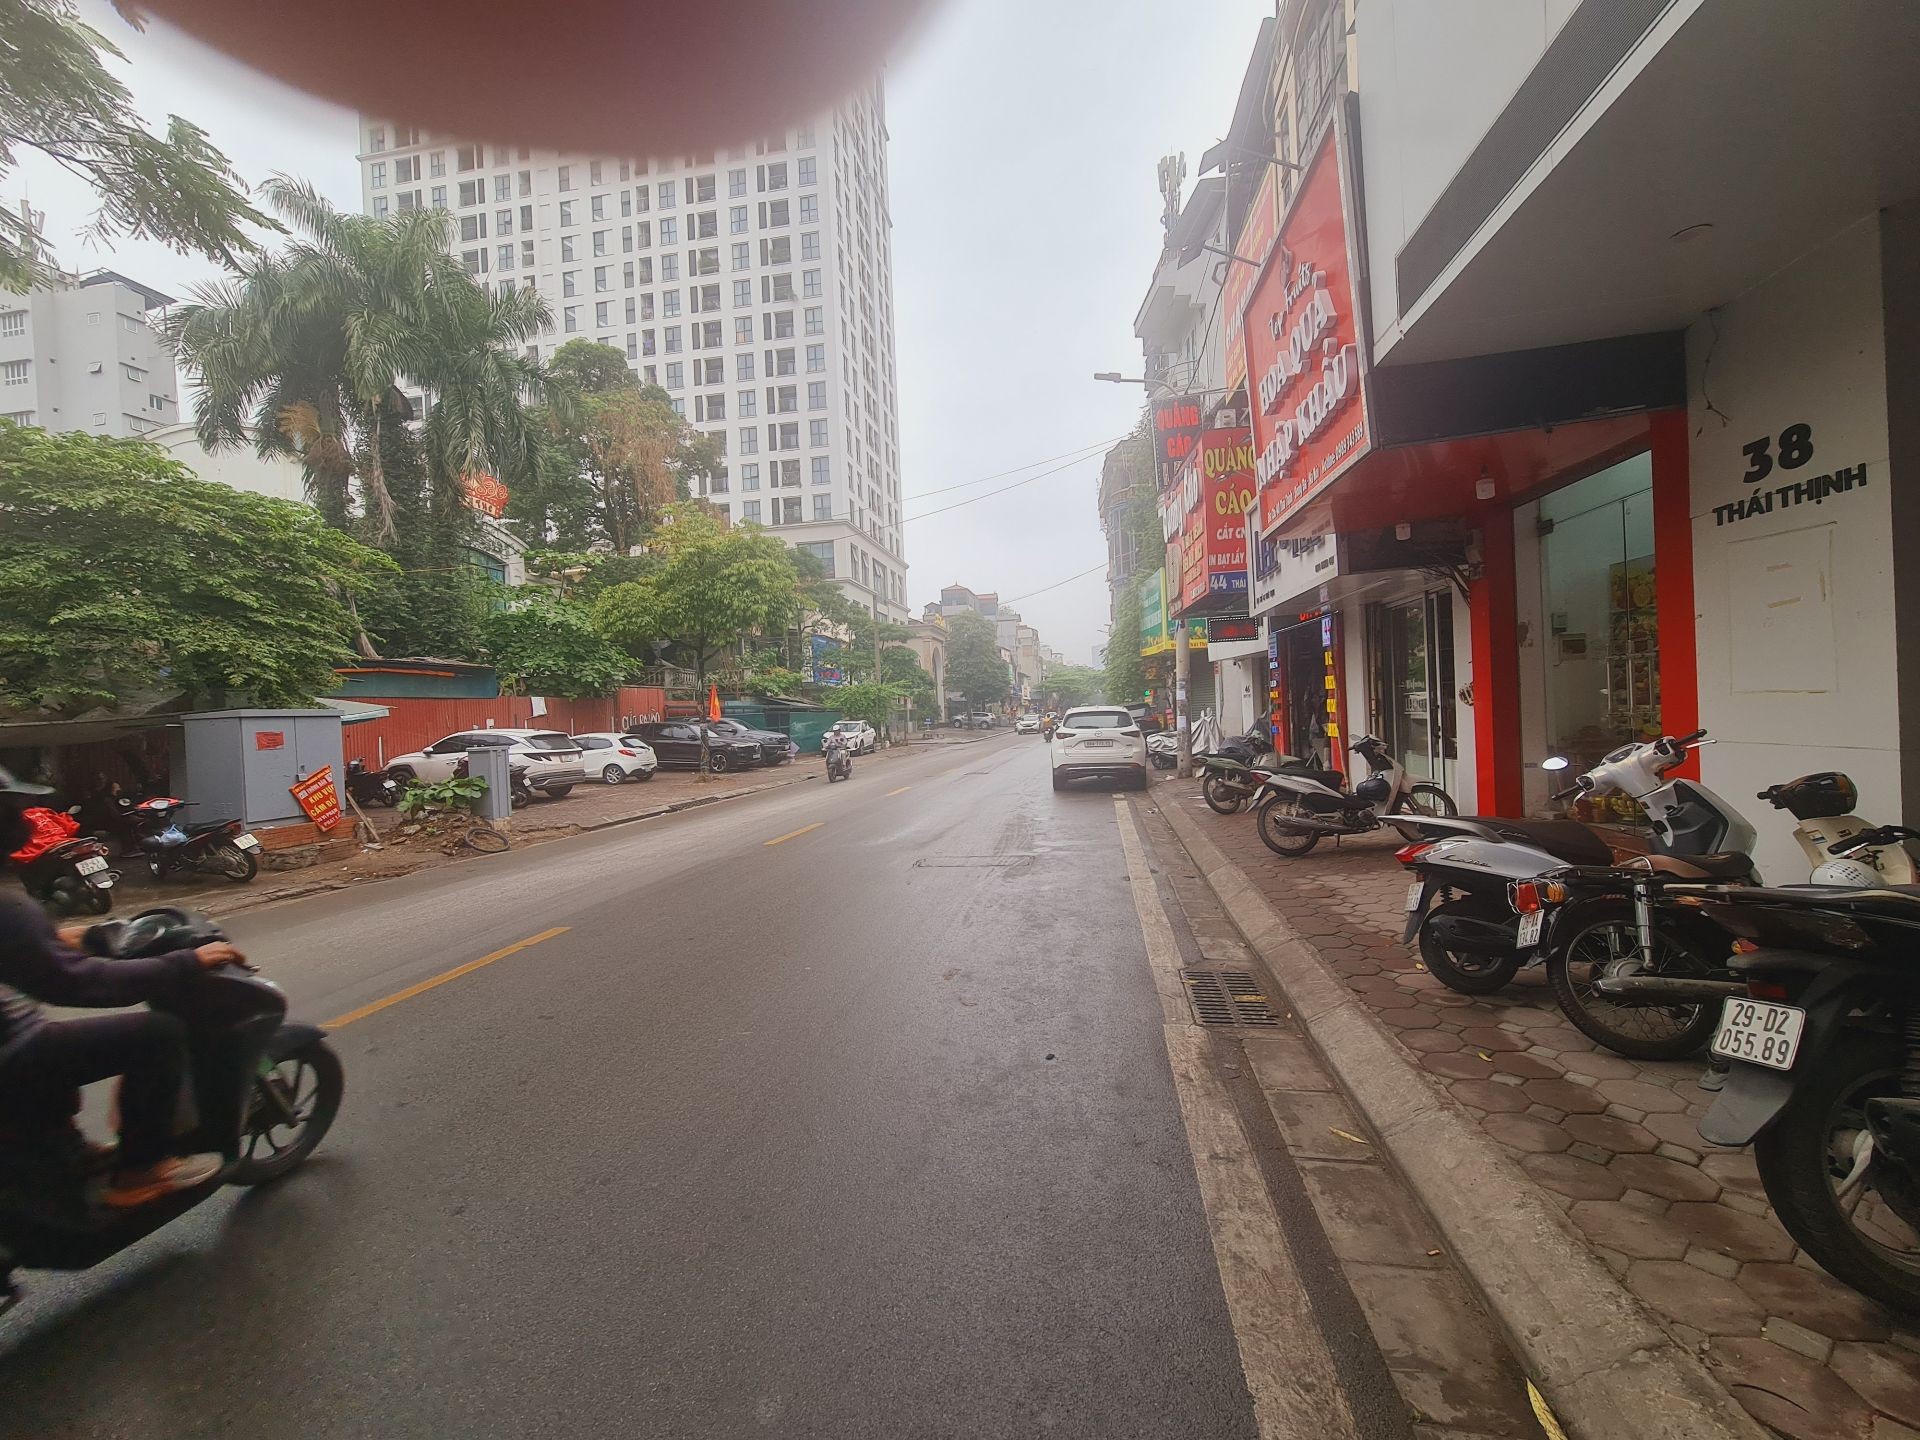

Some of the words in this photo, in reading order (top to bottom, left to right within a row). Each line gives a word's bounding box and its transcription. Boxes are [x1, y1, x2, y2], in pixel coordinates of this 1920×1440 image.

[1259, 350, 1289, 416] HOA
[1290, 271, 1334, 374] QUẢ
[1257, 419, 1294, 490] NHẬP
[1296, 338, 1355, 446] KHẨU
[1742, 423, 1814, 483] 38
[1215, 483, 1252, 515] CÁO
[1712, 488, 1773, 526] THÁI
[1776, 462, 1867, 508] THỊNH
[1210, 575, 1227, 590] 44
[1731, 1002, 1790, 1035] 29-D2
[1720, 1028, 1790, 1064] 055.89
